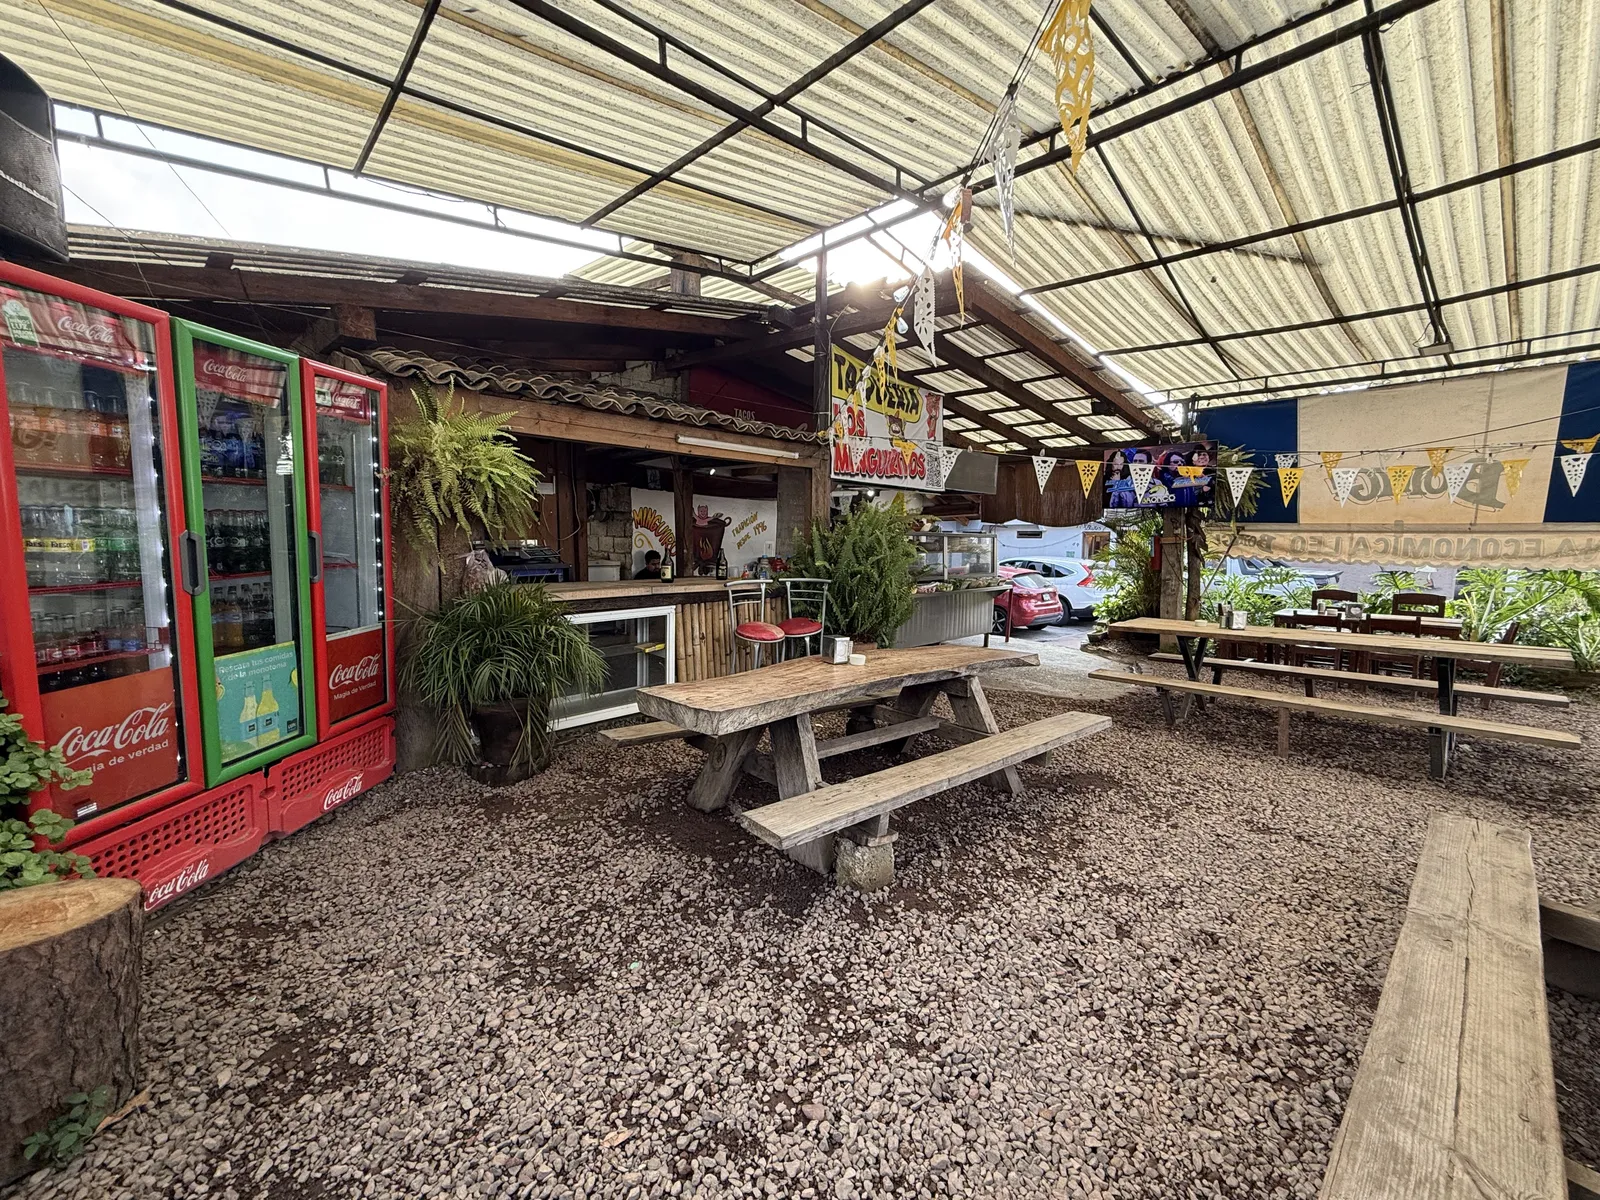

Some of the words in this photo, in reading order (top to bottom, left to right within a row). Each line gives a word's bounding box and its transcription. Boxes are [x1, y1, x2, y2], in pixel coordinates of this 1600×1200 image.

[57, 316, 115, 343] Coca-Cola
[203, 359, 248, 383] Coca-Cola
[733, 408, 756, 421] TACOS
[753, 521, 768, 536] 1996
[252, 657, 263, 667] tus
[264, 651, 293, 663] comidas
[329, 653, 381, 690] Coca-Cola
[333, 690, 350, 700] Magia
[359, 680, 377, 691] Verdad
[57, 701, 173, 766] Coca-Cola
[108, 756, 125, 767] de
[128, 739, 169, 759] verdad
[323, 772, 364, 811] Coca-Cola
